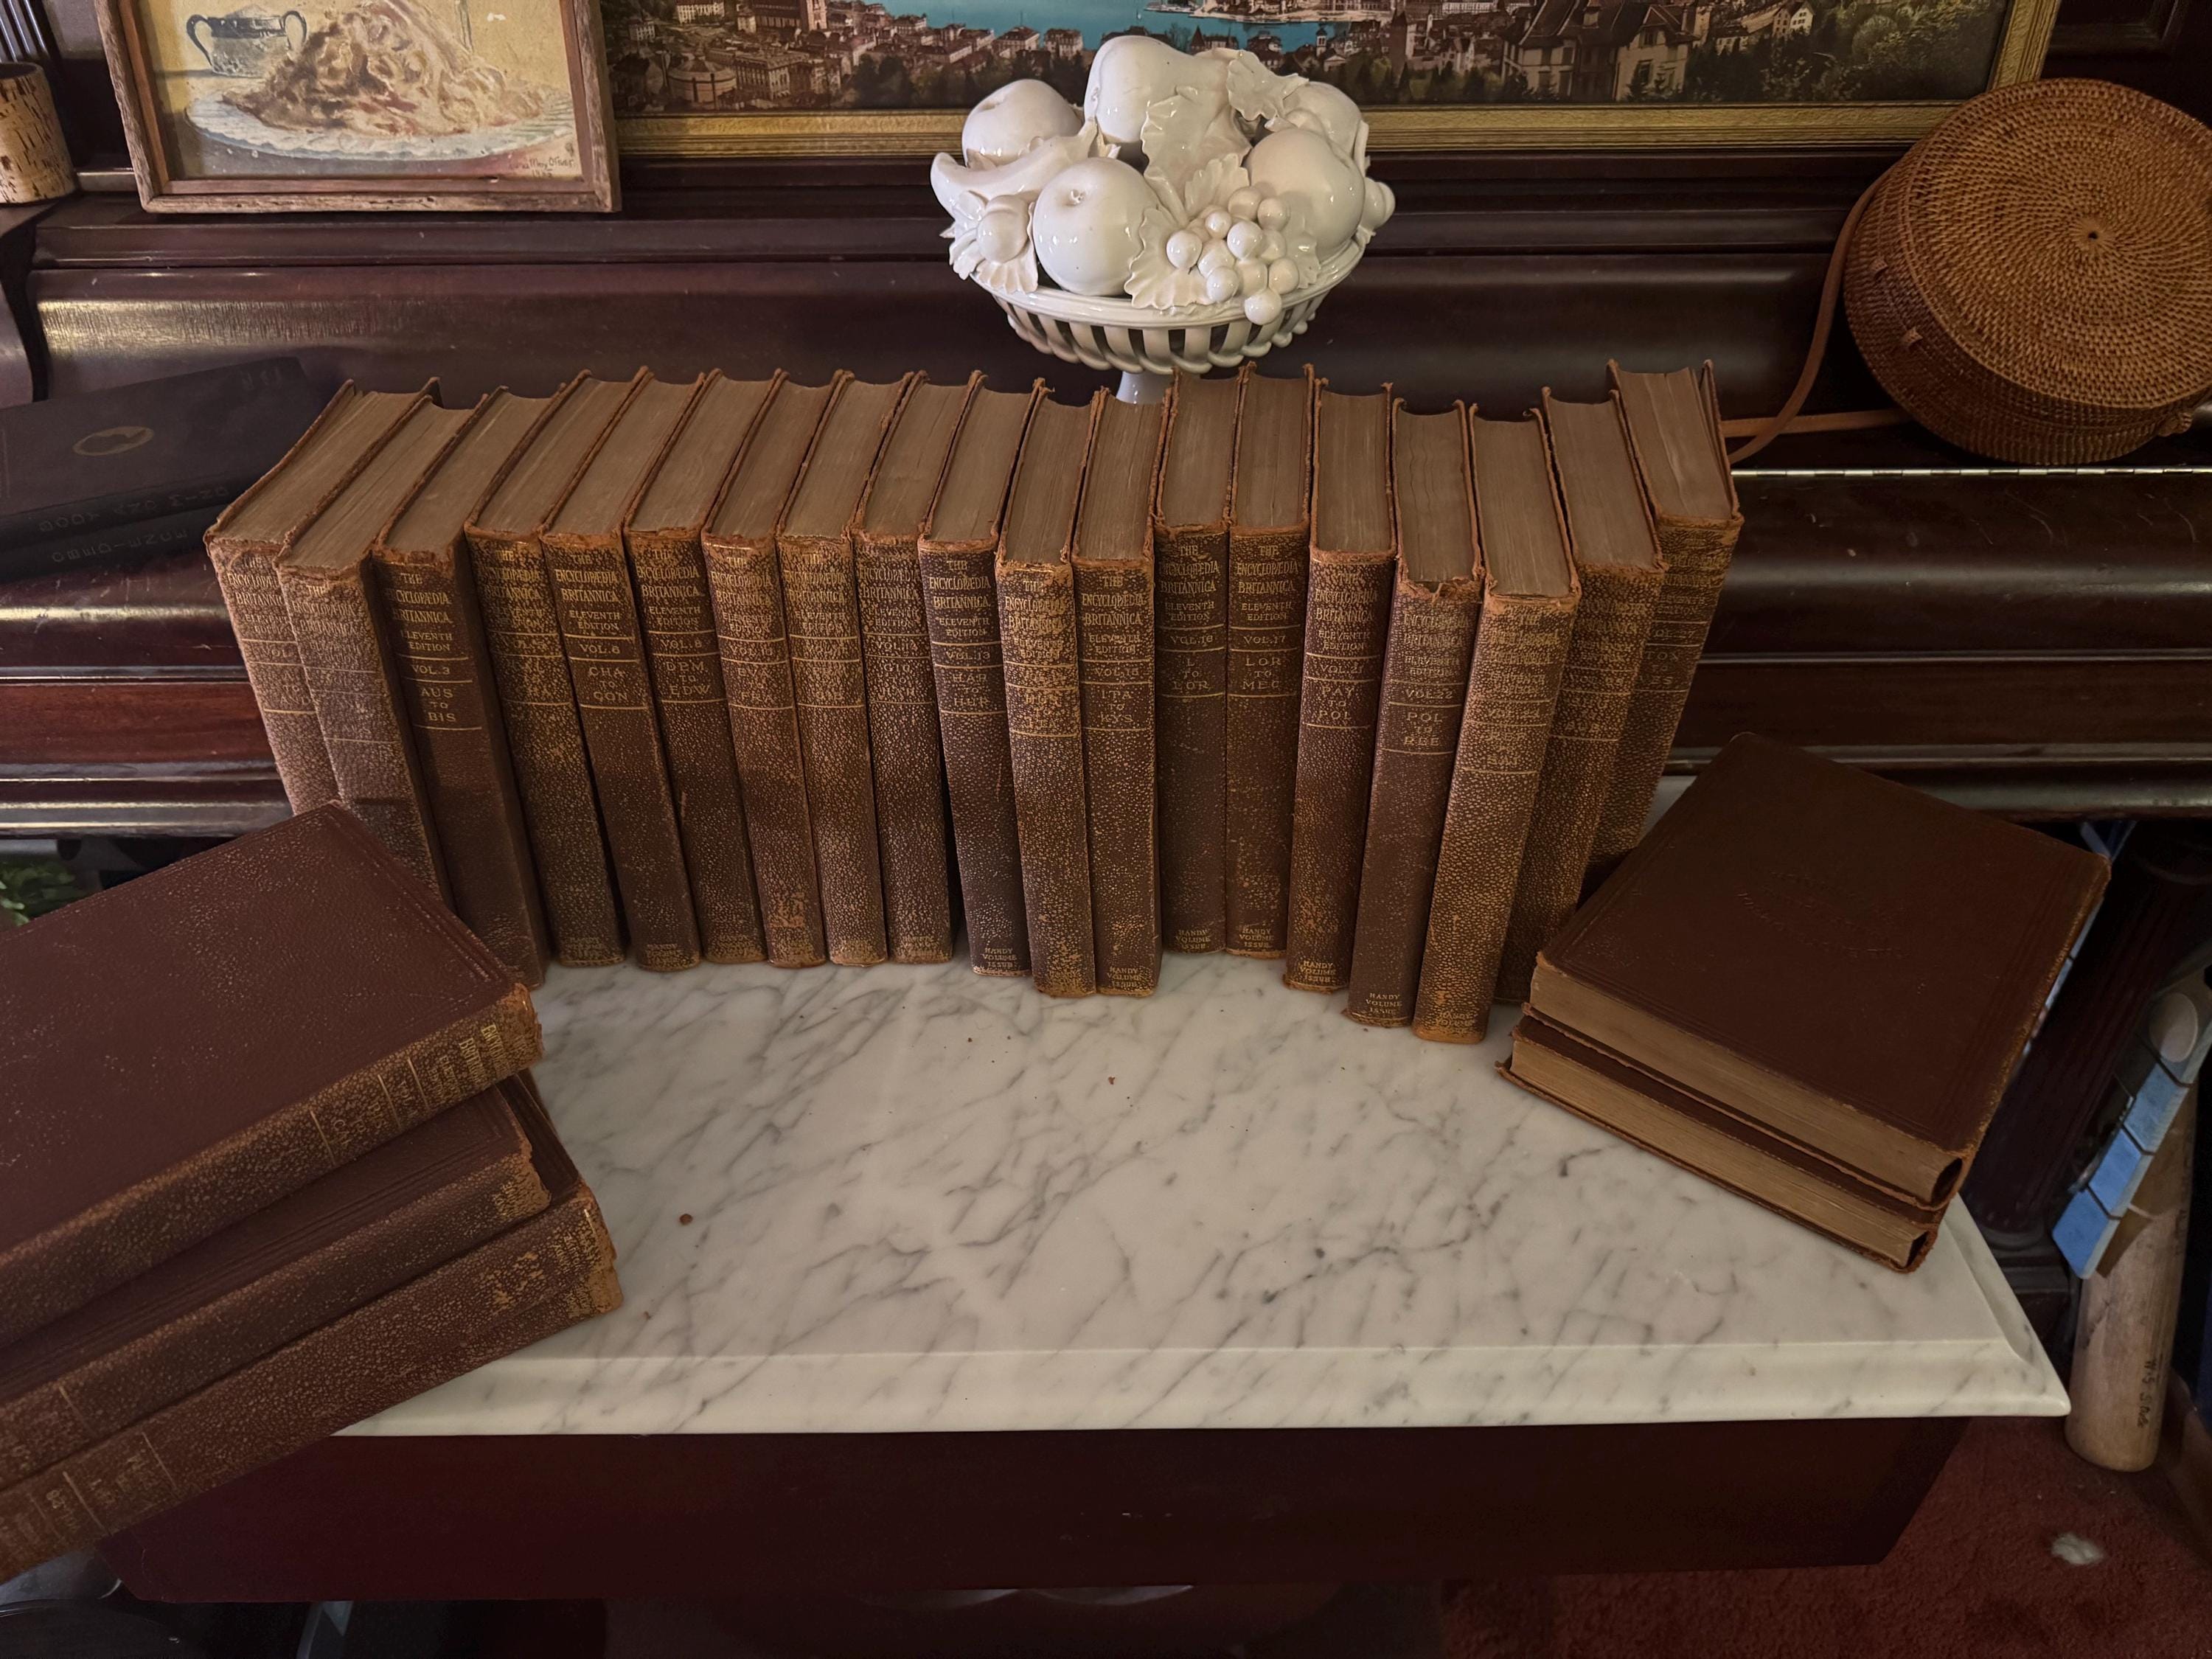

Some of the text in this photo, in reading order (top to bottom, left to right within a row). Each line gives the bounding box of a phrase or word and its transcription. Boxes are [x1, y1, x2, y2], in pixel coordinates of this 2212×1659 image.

[1180, 545, 1200, 557] THE
[1258, 545, 1280, 557] THE
[572, 554, 591, 566] THE
[947, 560, 968, 571] THE
[1236, 560, 1299, 577] ENCYCLOPÆDIA
[554, 568, 619, 583] ENCYCLOPÆDIA
[636, 566, 700, 580] ENCYCLOPÆDIA
[400, 572, 423, 585] THE
[929, 576, 992, 590] ENCYCLOPÆDIA
[1102, 576, 1124, 588] THE
[641, 585, 700, 598] BRITANNICA
[1161, 580, 1217, 594] BRITANNICA
[1238, 580, 1295, 594] BRITANNICA
[561, 588, 620, 602] BRITANNICA
[716, 589, 773, 606] BRITANNICA
[1081, 592, 1144, 607] ENCYCLOPÆDIA
[933, 595, 992, 609] BRITANNICA
[1165, 601, 1215, 611] ELEVENTH
[1241, 600, 1293, 611] ELEVENTH
[569, 610, 621, 620] ELEVENTH
[649, 606, 701, 615] ELEVENTH
[1315, 607, 1374, 622] BRITANNICA
[1084, 613, 1142, 627] BRITANNICA
[1170, 613, 1211, 622] EDITION
[1248, 612, 1288, 621] EDITION
[578, 622, 619, 631] EDITION
[939, 617, 990, 627] ELEVENTH
[946, 629, 987, 638] EDITION
[1089, 634, 1141, 644] ELEVENTH
[1243, 635, 1286, 644] VOL.17
[408, 641, 451, 652] EDITION
[1096, 645, 1136, 654] EDITION
[1186, 658, 1195, 667] L
[1245, 657, 1282, 667] LOR
[589, 667, 627, 677] CHA
[738, 667, 771, 678] EVA
[1182, 670, 1200, 678] TO
[1253, 669, 1273, 678] TO
[678, 675, 698, 683] TO
[953, 673, 988, 683] HAR
[599, 680, 616, 689] TO
[1172, 681, 1209, 691] LOR
[1242, 681, 1281, 690] MEC
[421, 686, 454, 698] AUS
[670, 685, 712, 696] EDW
[963, 686, 980, 695] TO
[1102, 690, 1133, 700] ITA
[1321, 686, 1355, 697] PAY
[593, 691, 628, 701] CON
[431, 701, 449, 709] TO
[1107, 703, 1125, 711] TO
[1328, 700, 1347, 708] TO
[428, 712, 456, 722] BIS
[1318, 710, 1352, 720] POL
[1406, 712, 1444, 723] POL
[1303, 959, 1334, 969] HANDY
[1369, 992, 1401, 1001] HANDY
[1366, 998, 1402, 1007] VOLUME
